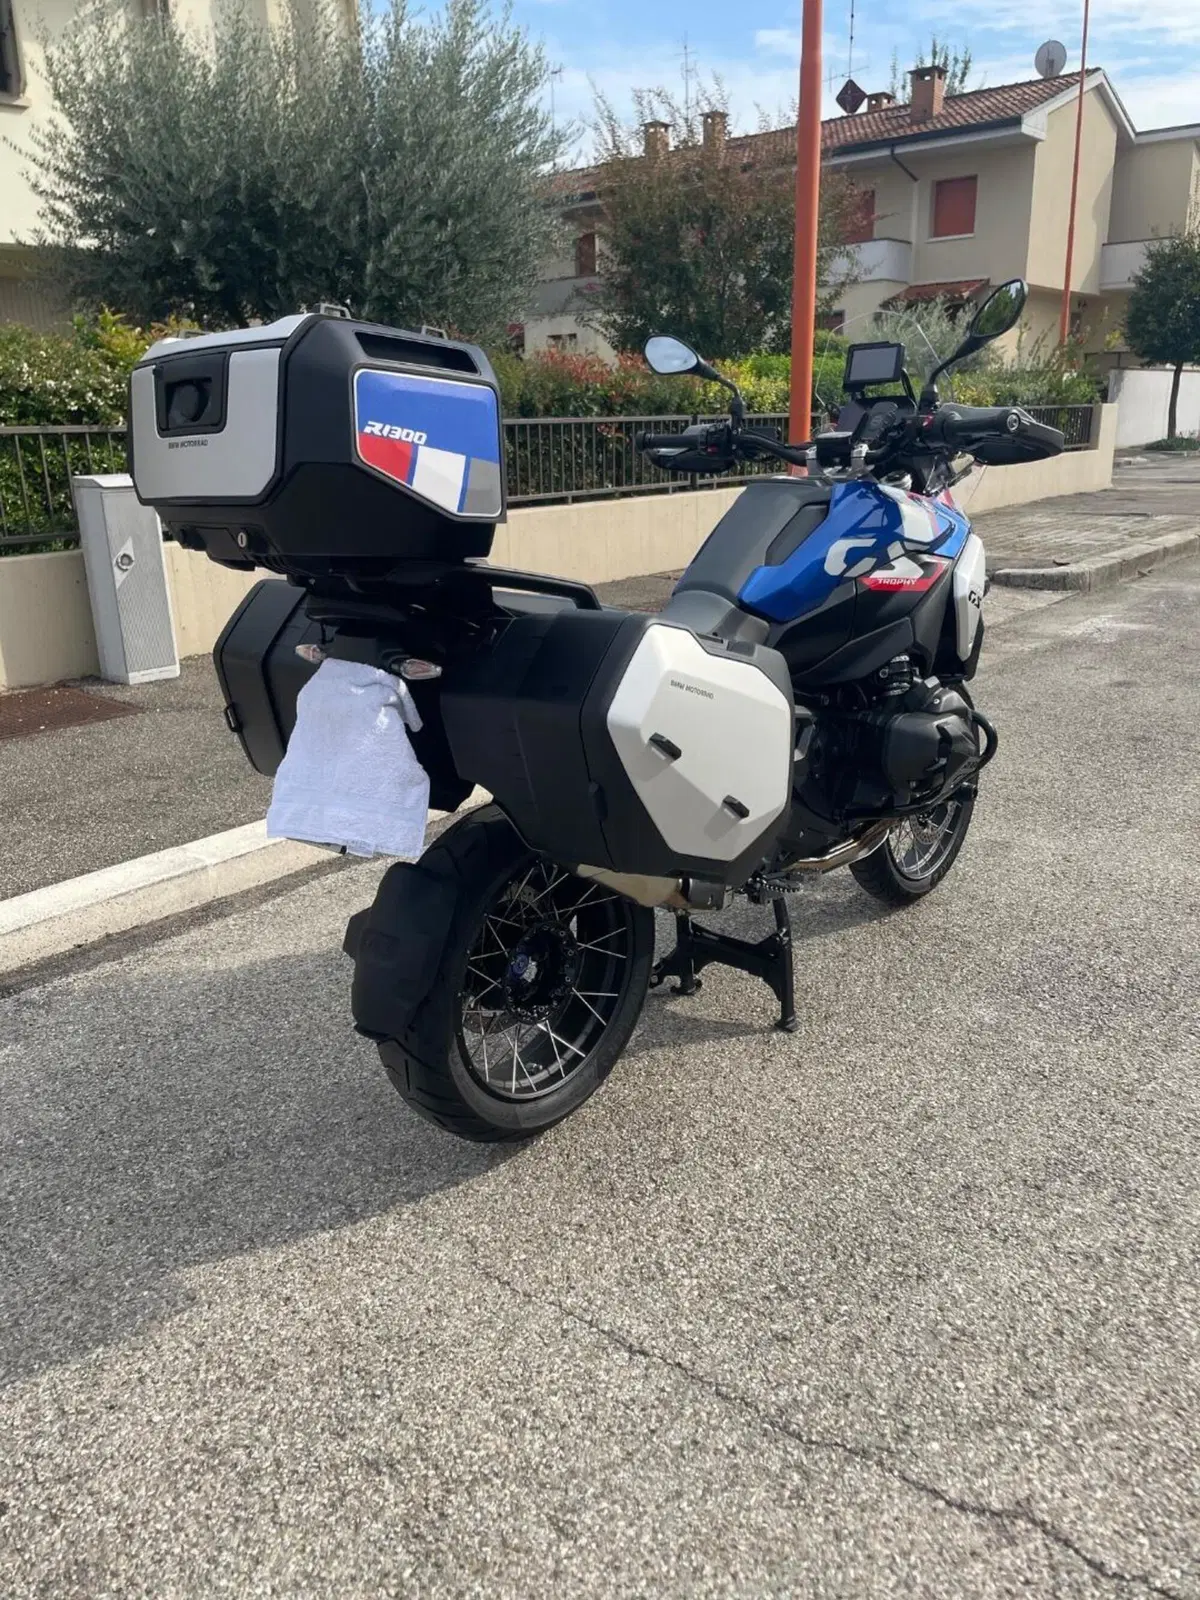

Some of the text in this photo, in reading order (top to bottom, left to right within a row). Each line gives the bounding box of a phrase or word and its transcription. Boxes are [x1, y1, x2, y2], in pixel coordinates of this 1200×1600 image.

[363, 420, 428, 445] R1300
[824, 538, 925, 578] GS
[878, 578, 917, 586] TROPHY
